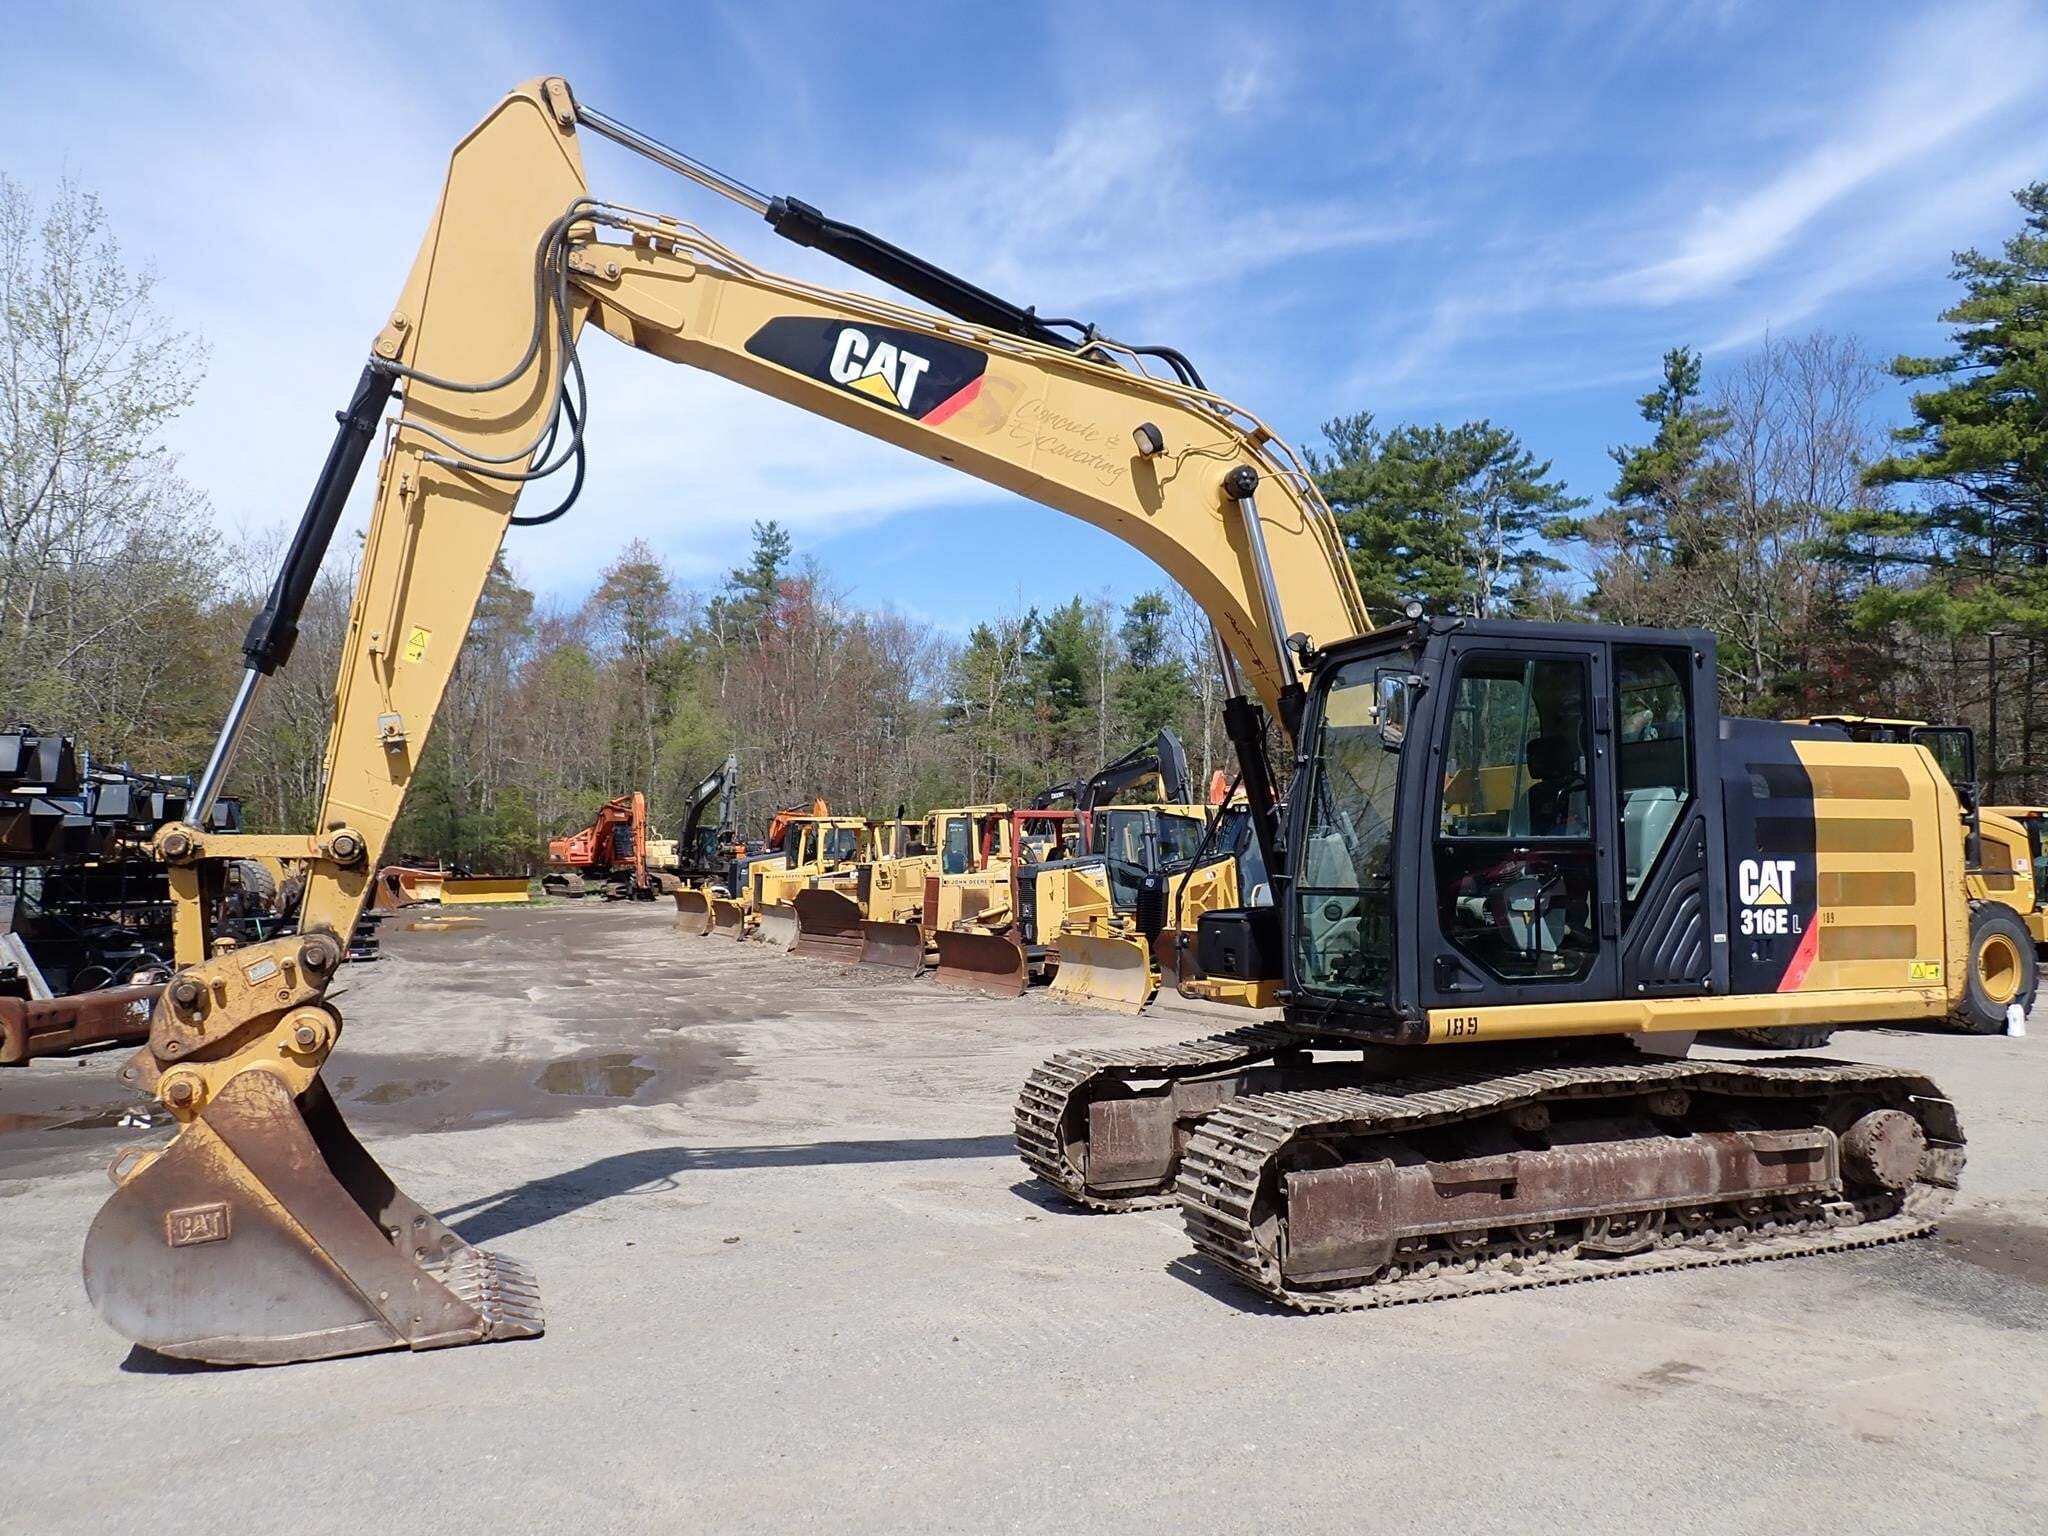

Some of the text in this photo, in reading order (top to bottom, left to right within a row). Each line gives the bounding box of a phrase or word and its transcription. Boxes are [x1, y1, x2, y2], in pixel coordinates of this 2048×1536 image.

[829, 327, 930, 410] CAT
[1739, 859, 1796, 905] CAT
[1740, 908, 1802, 935] 316E L
[1445, 1017, 1478, 1037] 189
[175, 1211, 221, 1242] CAT
